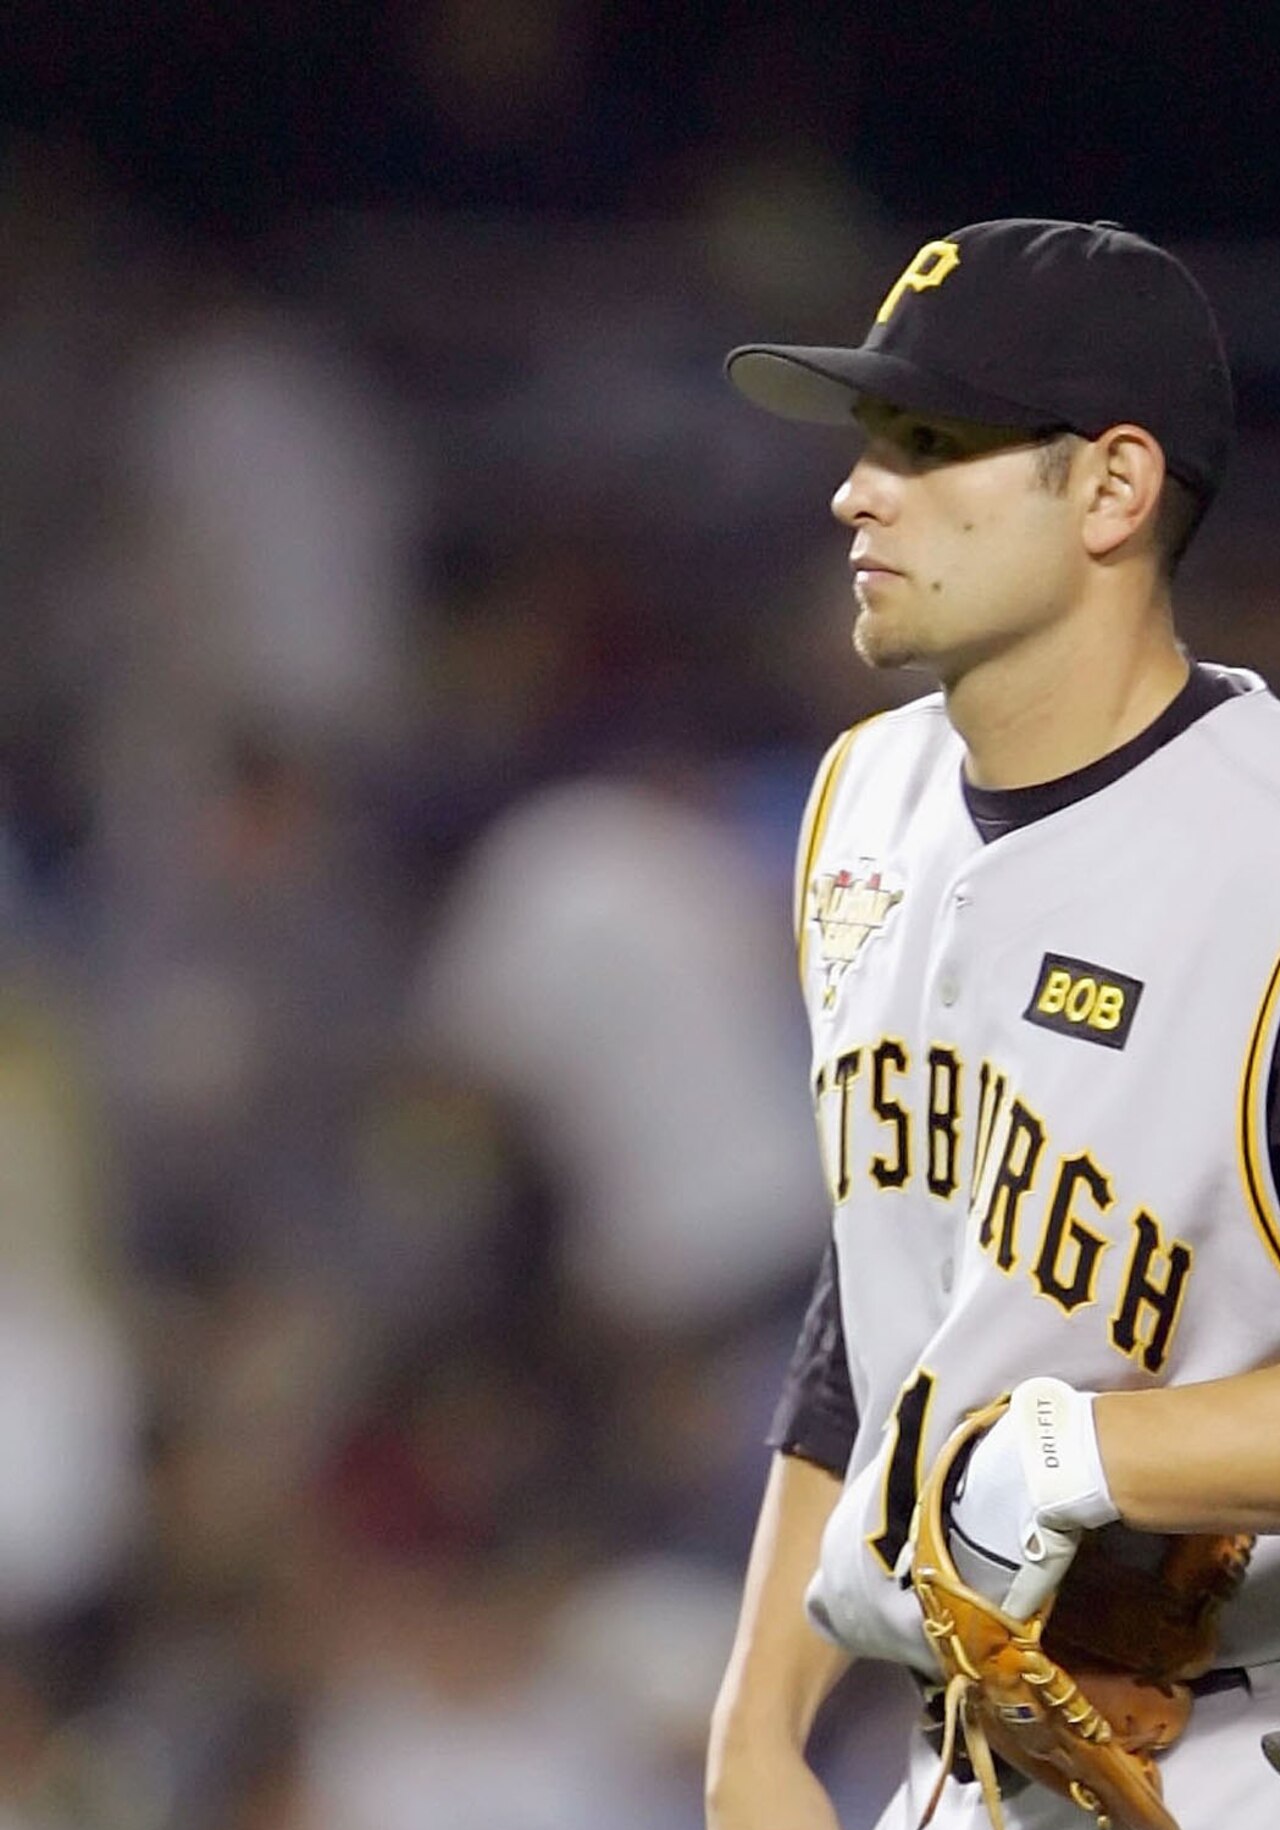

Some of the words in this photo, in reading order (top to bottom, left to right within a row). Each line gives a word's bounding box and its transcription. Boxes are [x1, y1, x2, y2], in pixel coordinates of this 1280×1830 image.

[876, 240, 960, 325] P
[1037, 969, 1125, 1030] BOB
[813, 1036, 1193, 1377] TSBURGH
